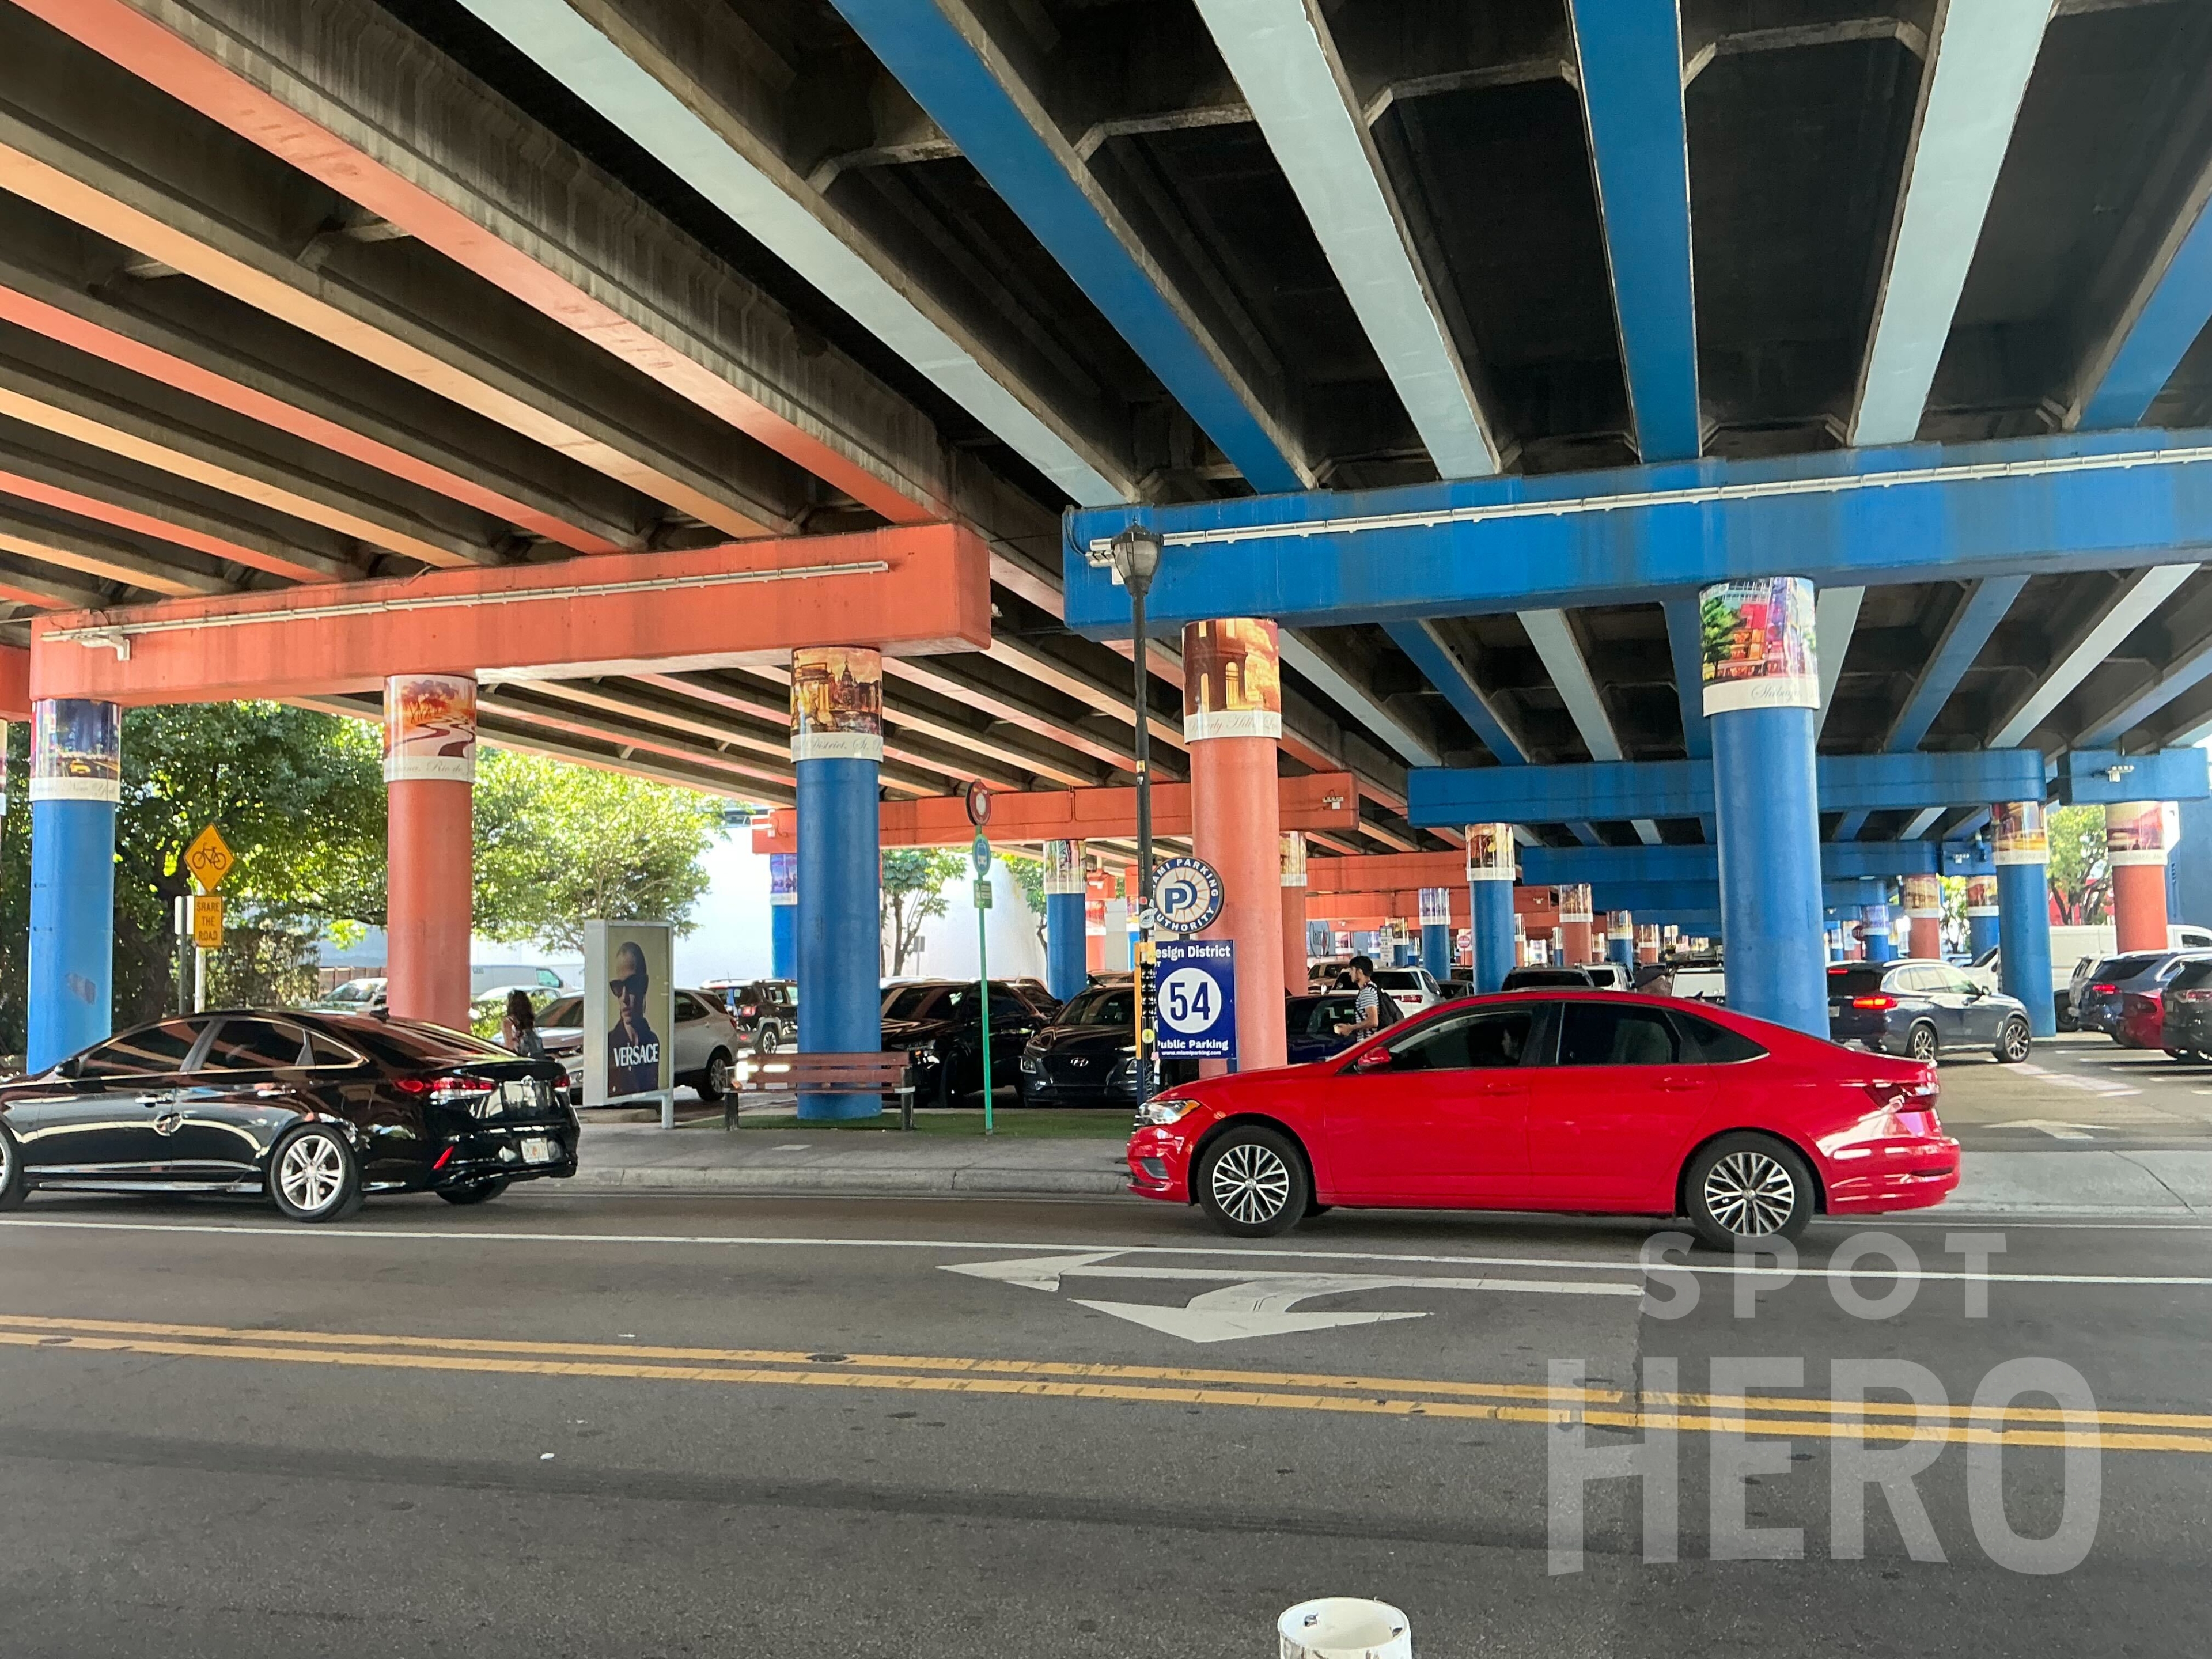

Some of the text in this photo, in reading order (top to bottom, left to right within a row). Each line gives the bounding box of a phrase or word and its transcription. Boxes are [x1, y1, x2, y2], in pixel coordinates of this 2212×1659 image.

[1176, 858, 1218, 897] PARKING
[196, 902, 220, 912] SHARE
[202, 916, 216, 926] THE
[198, 930, 218, 940] ROAD
[1155, 944, 1231, 961] esign District
[1169, 982, 1210, 1021] 54
[1188, 1039, 1229, 1051] Parking
[613, 1043, 659, 1067] VERSACE
